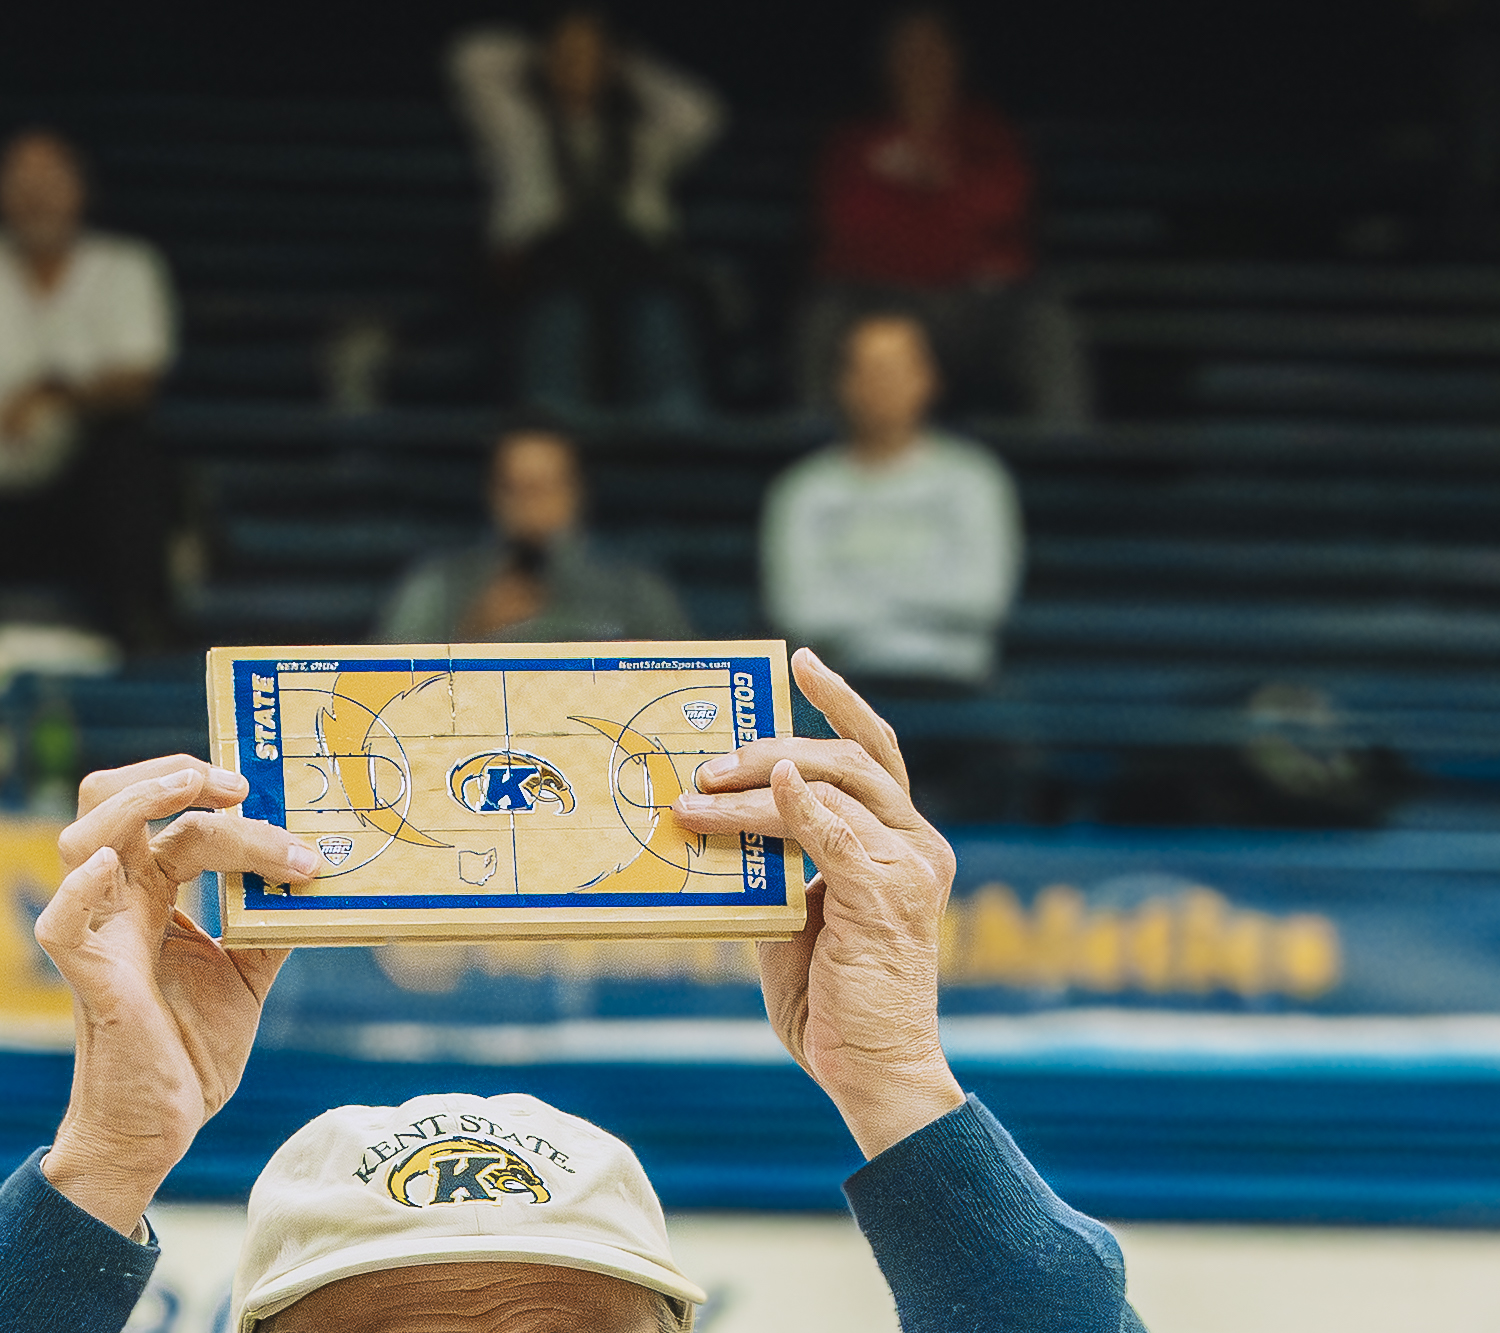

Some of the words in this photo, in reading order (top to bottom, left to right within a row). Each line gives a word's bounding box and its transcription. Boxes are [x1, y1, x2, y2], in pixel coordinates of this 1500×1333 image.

[619, 661, 730, 670] KentStateSports.com
[252, 673, 278, 761] STATE
[687, 710, 715, 719] MAC
[480, 768, 538, 811] K
[322, 845, 351, 853] MAC
[746, 831, 767, 890] SHES
[352, 1114, 447, 1184] KENT
[460, 1115, 572, 1173] STATE
[429, 1157, 501, 1206] K
